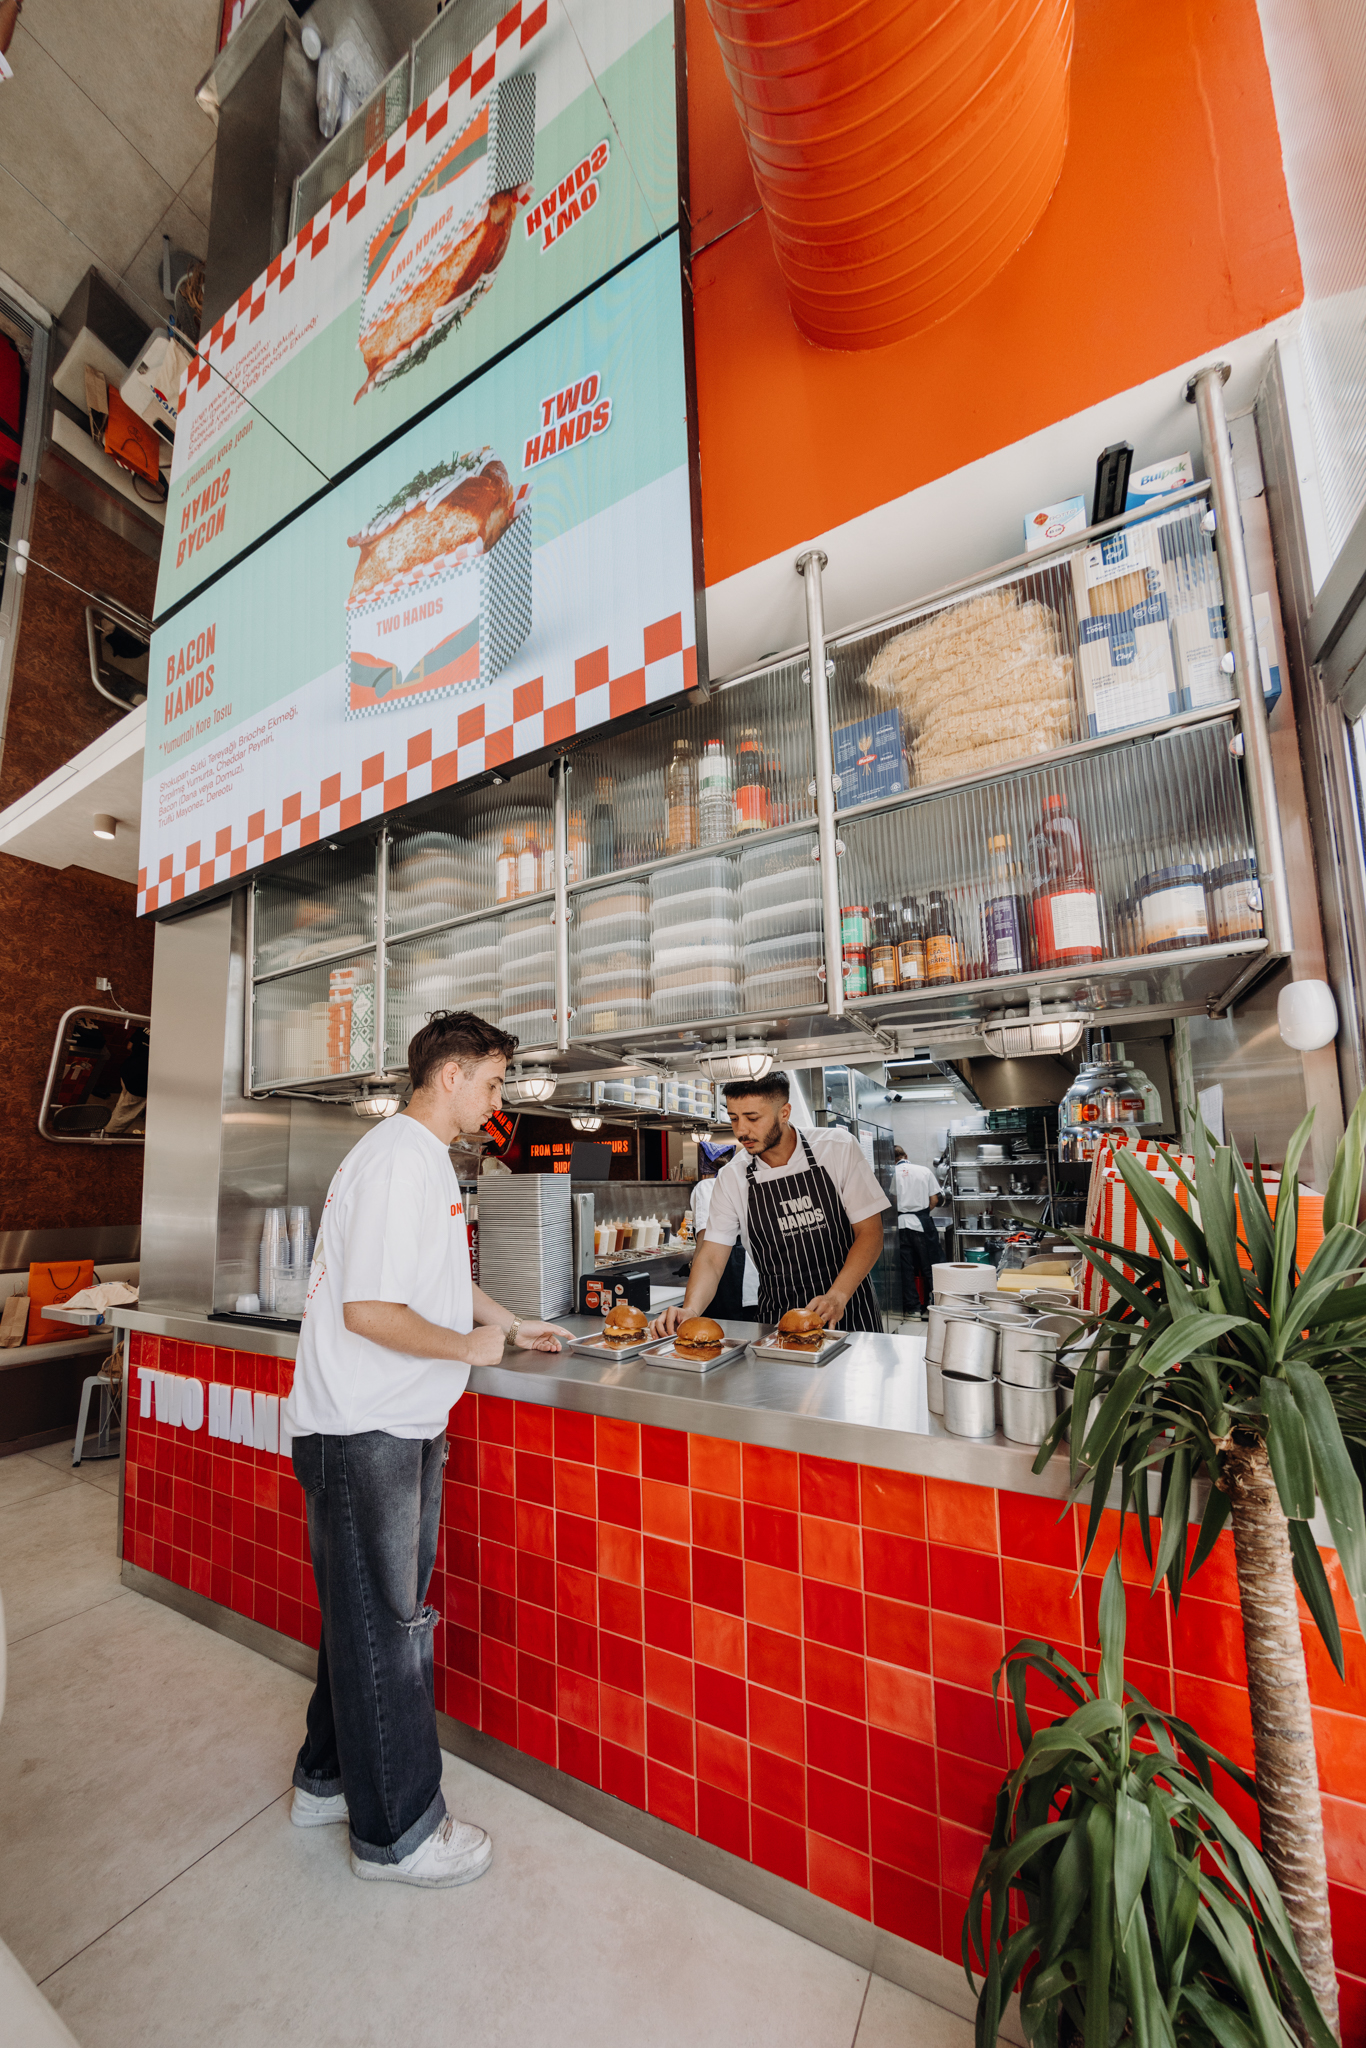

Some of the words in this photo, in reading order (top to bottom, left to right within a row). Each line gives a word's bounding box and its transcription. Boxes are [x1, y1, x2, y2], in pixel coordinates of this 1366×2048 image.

[542, 374, 598, 427] TWO
[524, 400, 610, 468] HANDS
[1140, 461, 1187, 486] Bulpak
[376, 614, 400, 637] TWO
[403, 597, 444, 627] HANDS
[166, 622, 216, 687] BACON
[164, 664, 215, 726] HANDS
[195, 717, 211, 737] Kore
[213, 703, 232, 725] Tostu
[159, 770, 189, 792] Shokupan
[190, 757, 207, 775] Sütlü
[208, 741, 237, 764] Tereyağlı
[238, 724, 266, 747] Brioche
[268, 705, 299, 730] Ekmeği,
[186, 768, 215, 788] Yumurta,
[216, 748, 247, 772] Cheddar
[248, 732, 275, 755] Peyniri,
[158, 809, 175, 828] Trüflü
[175, 797, 205, 819] Mayonez,
[206, 784, 233, 803] Dereotu
[159, 801, 178, 816] Bacon
[178, 788, 198, 807] (Dana
[199, 781, 214, 795] veya
[531, 1144, 551, 1157] FROM
[552, 1143, 564, 1153] OUR
[553, 1161, 571, 1174] BUR
[450, 1202, 464, 1217] ON
[777, 1208, 824, 1231] HANDS
[779, 1195, 812, 1215] TWO
[468, 1229, 479, 1285] Suprem
[137, 1367, 204, 1431] TWO
